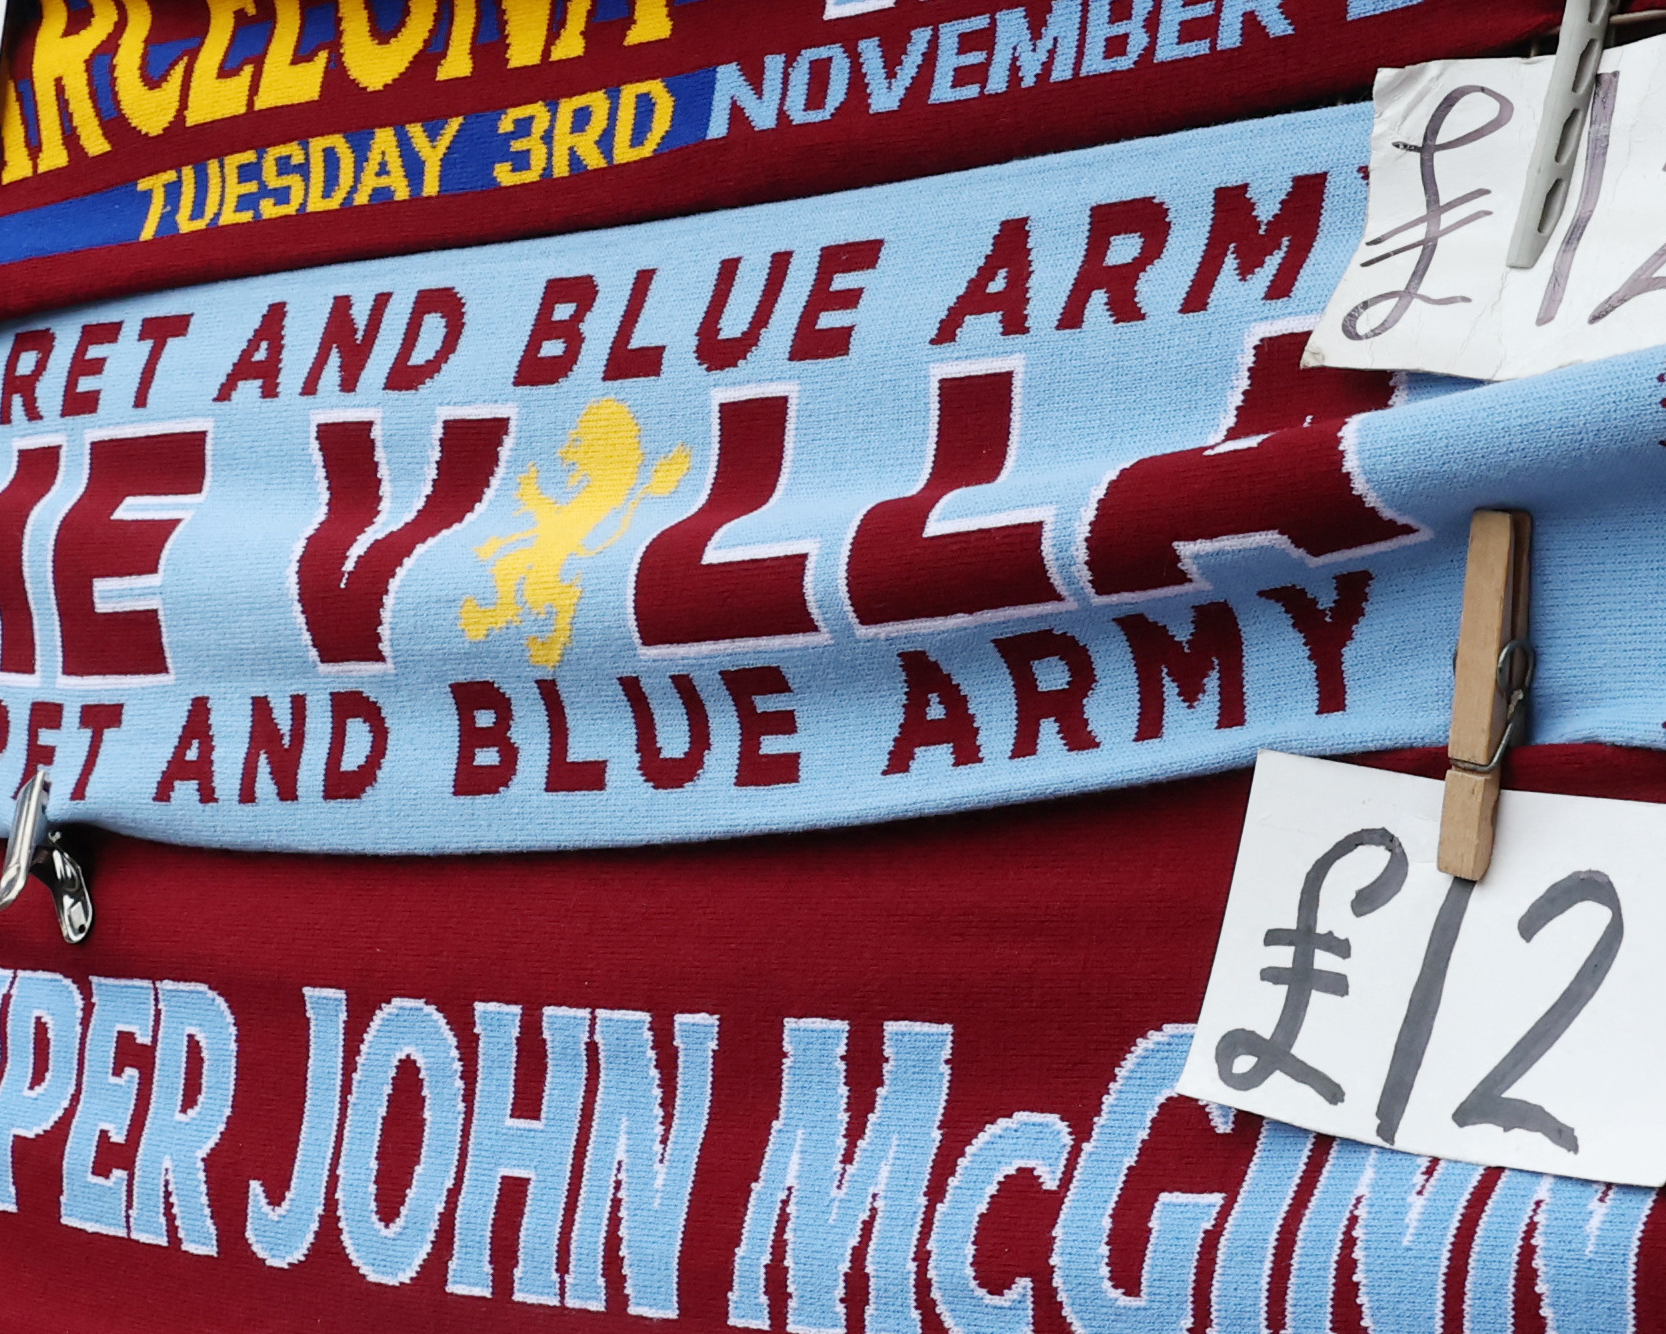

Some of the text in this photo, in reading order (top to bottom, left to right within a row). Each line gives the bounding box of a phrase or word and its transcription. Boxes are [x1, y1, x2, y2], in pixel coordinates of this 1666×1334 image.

[134, 115, 458, 242] TUESDAY
[493, 78, 676, 189] 3RD
[213, 286, 466, 403] AND
[514, 239, 884, 387] BLUE
[933, 166, 1369, 347] ARM
[153, 691, 389, 805] AND
[453, 668, 800, 797] BLUE
[881, 572, 1373, 777] ARMY
[1214, 826, 1625, 1155] £12
[245, 987, 721, 1320] JOHN
